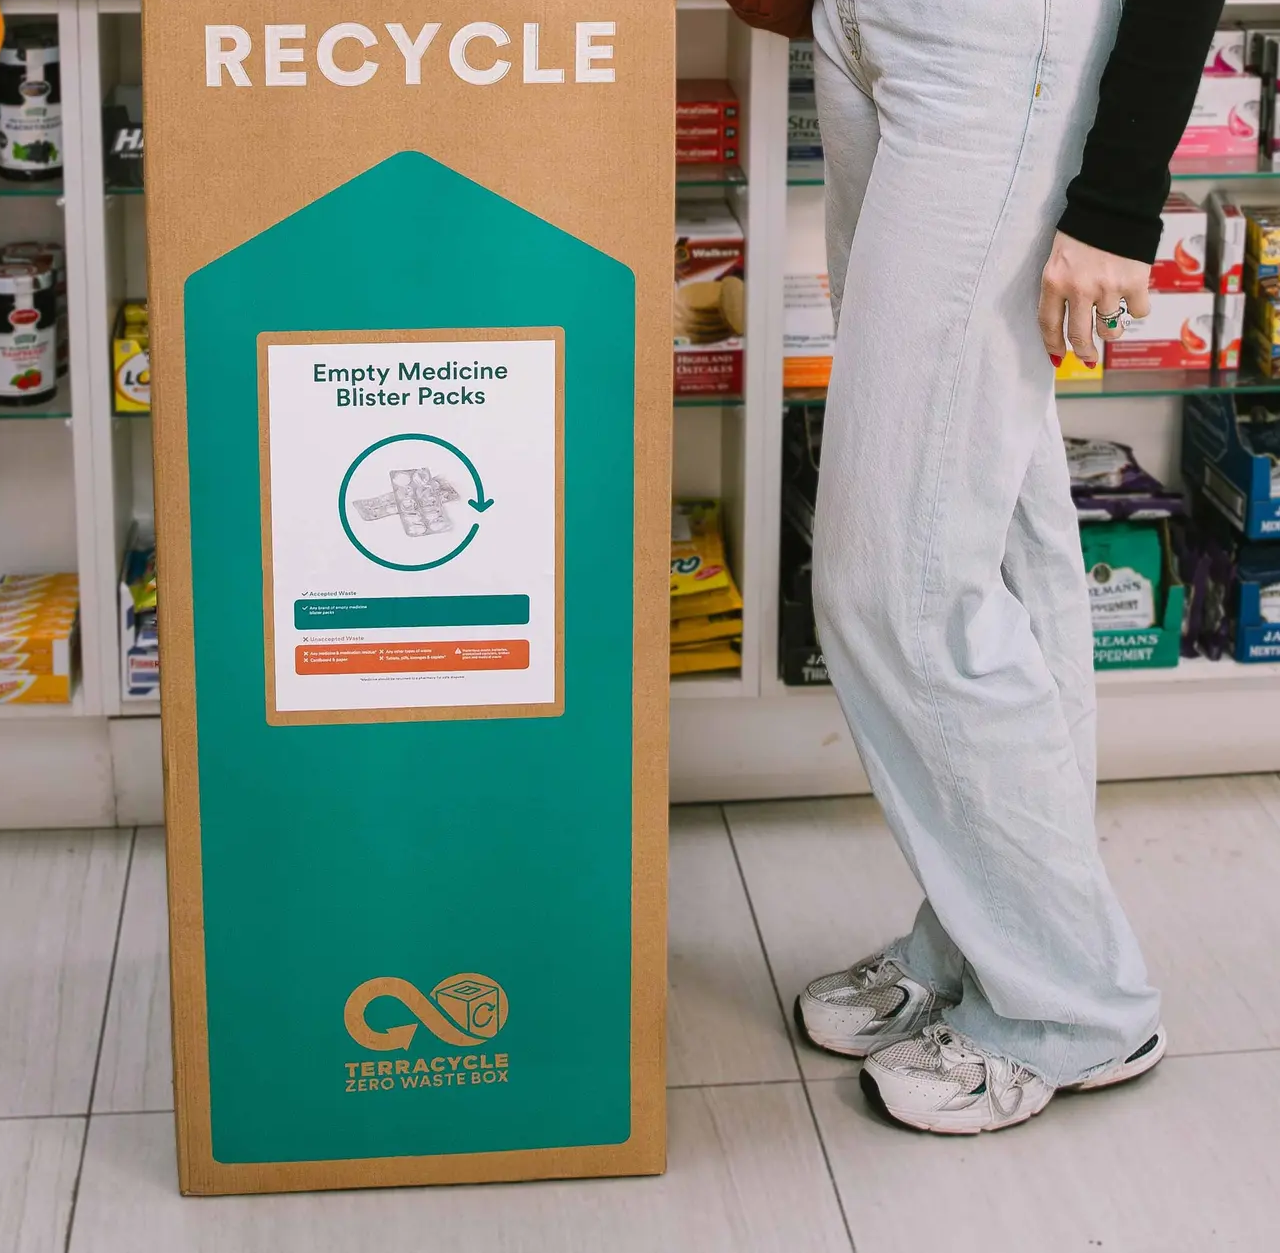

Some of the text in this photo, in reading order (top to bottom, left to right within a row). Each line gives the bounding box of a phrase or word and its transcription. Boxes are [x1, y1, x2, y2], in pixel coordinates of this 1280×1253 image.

[205, 21, 616, 87] RECYCLE
[692, 248, 741, 259] Walkers
[313, 361, 508, 386] Empty Medicine
[337, 386, 486, 407] Blister Packs
[345, 1053, 508, 1078] TERRACYCLE
[345, 1070, 509, 1092] ZERO WASTE BOX
